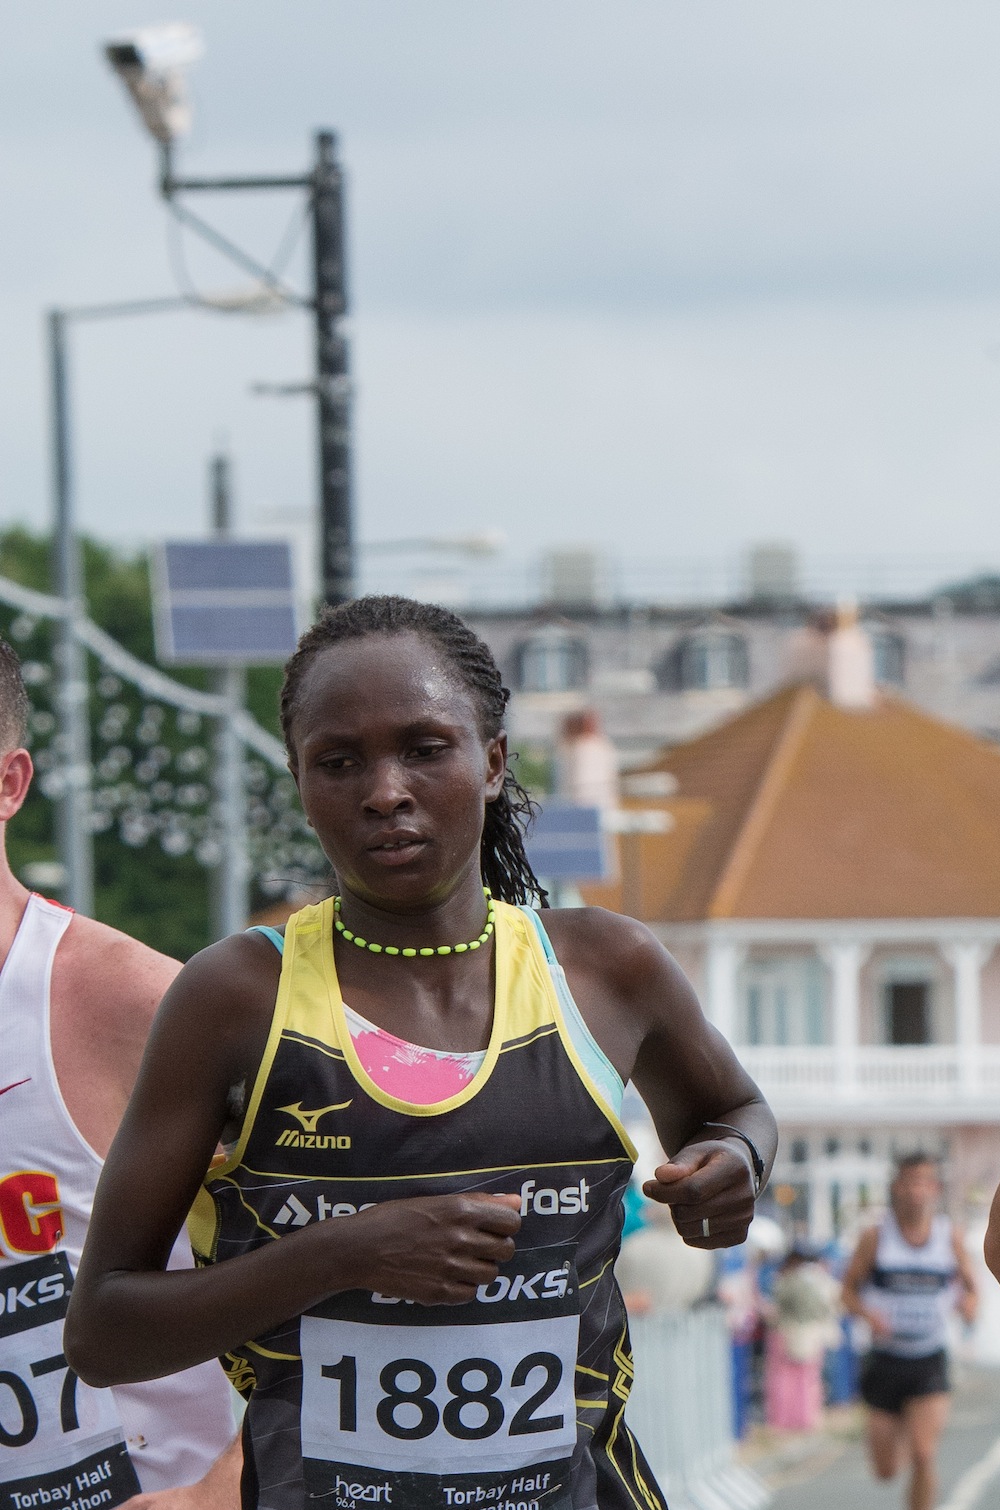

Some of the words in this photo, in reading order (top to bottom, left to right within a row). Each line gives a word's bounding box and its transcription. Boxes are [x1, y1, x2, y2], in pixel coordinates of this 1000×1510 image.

[520, 1178, 590, 1217] fast
[321, 1351, 564, 1441] 1882
[10, 1482, 72, 1510] Torbay
[76, 1460, 113, 1491] Half
[335, 1475, 393, 1504] heart
[443, 1482, 506, 1505] Torbay
[511, 1473, 551, 1494] Half
[335, 1497, 356, 1510] 96.4
